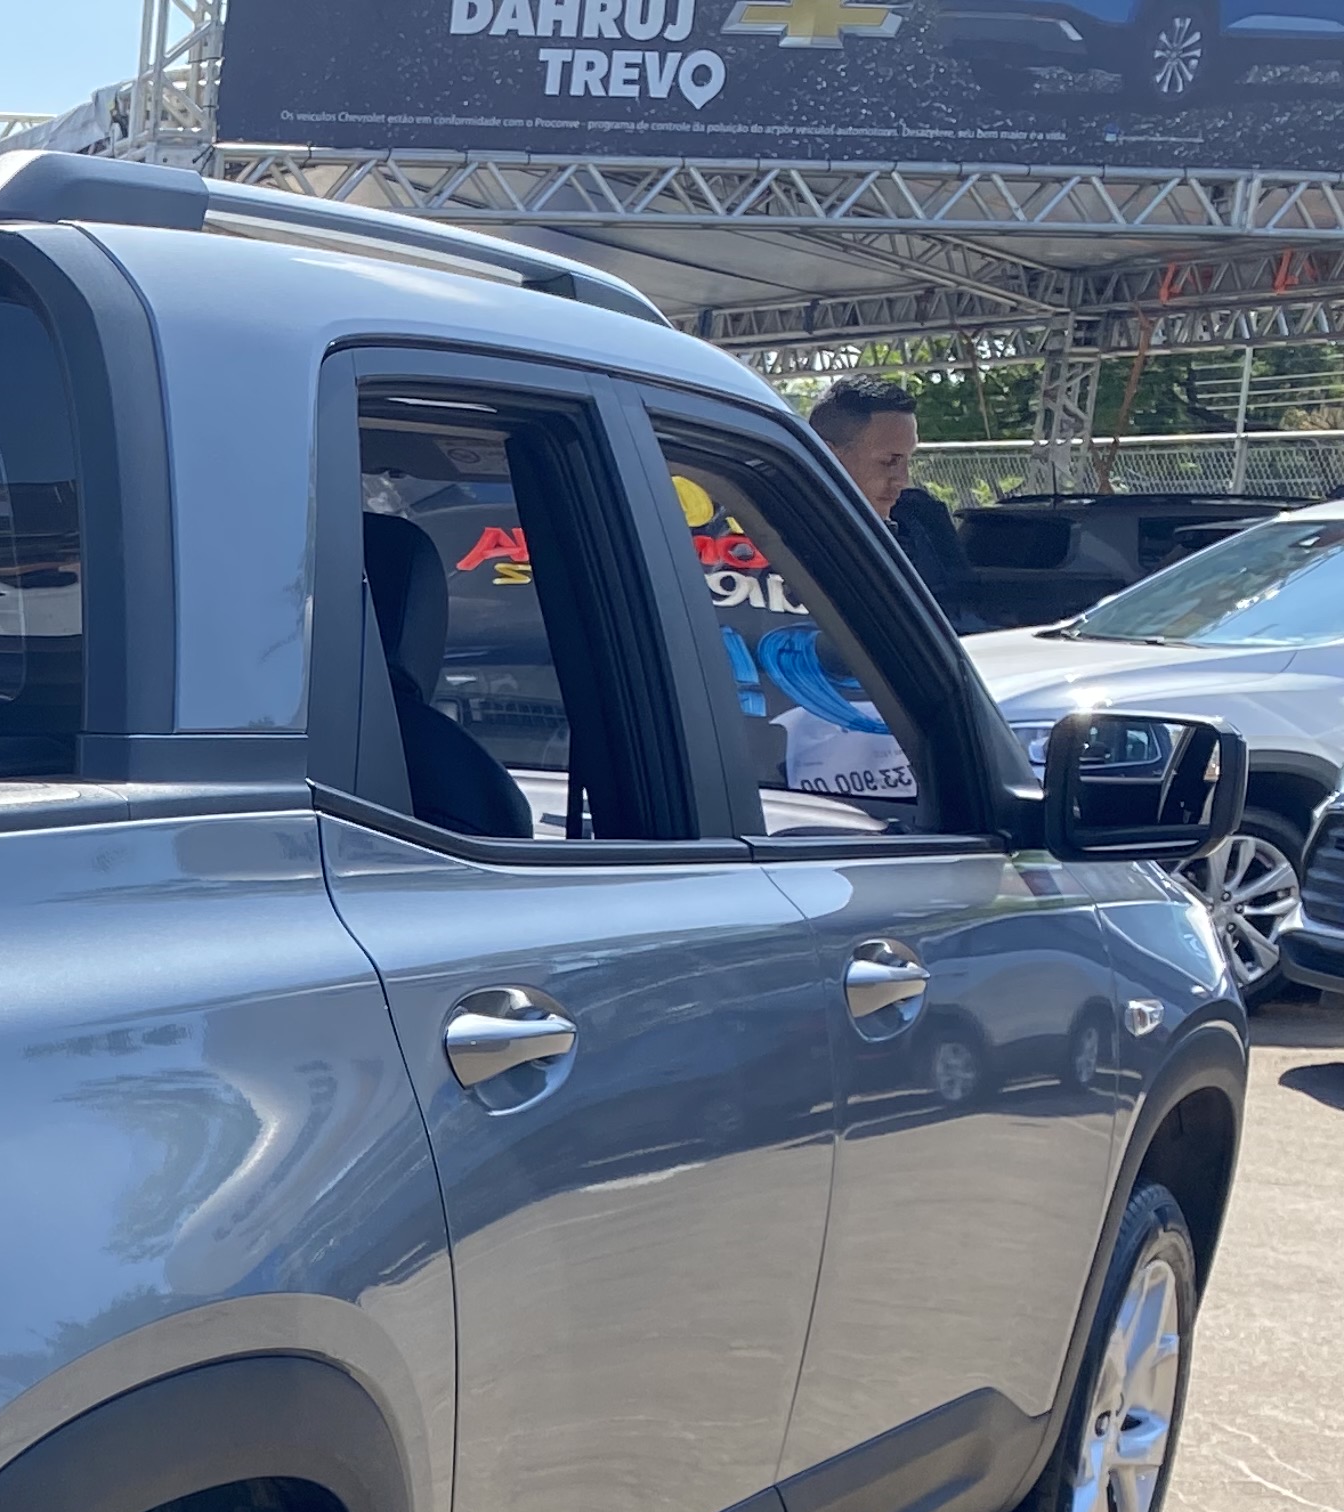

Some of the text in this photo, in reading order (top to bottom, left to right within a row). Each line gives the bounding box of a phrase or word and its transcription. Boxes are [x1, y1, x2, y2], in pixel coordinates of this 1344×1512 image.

[450, 0, 695, 41] DAHRUJ
[539, 48, 736, 110] TREVO
[280, 109, 294, 121] Os
[338, 111, 386, 123] Chevrolet
[415, 115, 432, 125] em
[433, 113, 501, 127] conformidade
[502, 118, 524, 128] com
[534, 117, 580, 129] Proconve
[587, 120, 635, 132] programa
[636, 119, 649, 130] de
[650, 120, 691, 132] controle
